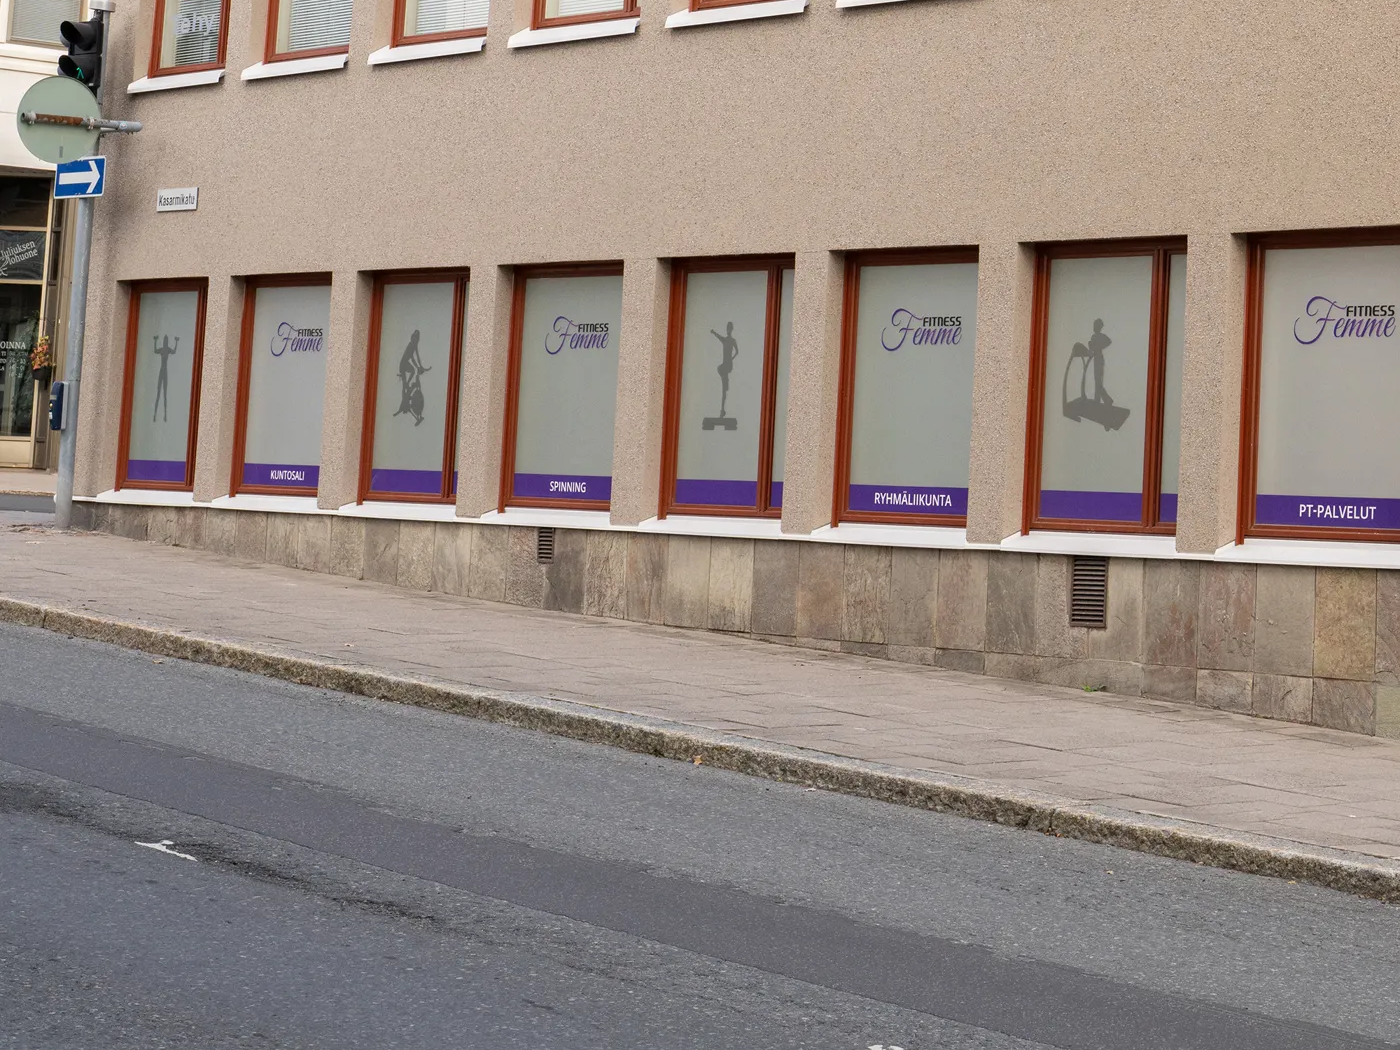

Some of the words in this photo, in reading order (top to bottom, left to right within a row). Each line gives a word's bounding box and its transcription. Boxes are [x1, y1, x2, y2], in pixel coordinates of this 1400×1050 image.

[158, 193, 195, 206] Kasarmikatu
[1346, 305, 1396, 317] FITNESS
[922, 316, 962, 327] FITNESS
[1293, 295, 1397, 345] Femme
[297, 328, 323, 337] FITNESS
[577, 323, 609, 333] FITNESS
[881, 307, 962, 352] Femme
[270, 321, 324, 357] Femme
[544, 315, 610, 355] Femme
[270, 470, 305, 481] KUNTOSALI
[549, 480, 587, 493] SPINNING
[874, 490, 953, 507] RYHMÄLIIKUNTA
[1299, 503, 1377, 520] PT-PALVELUT
